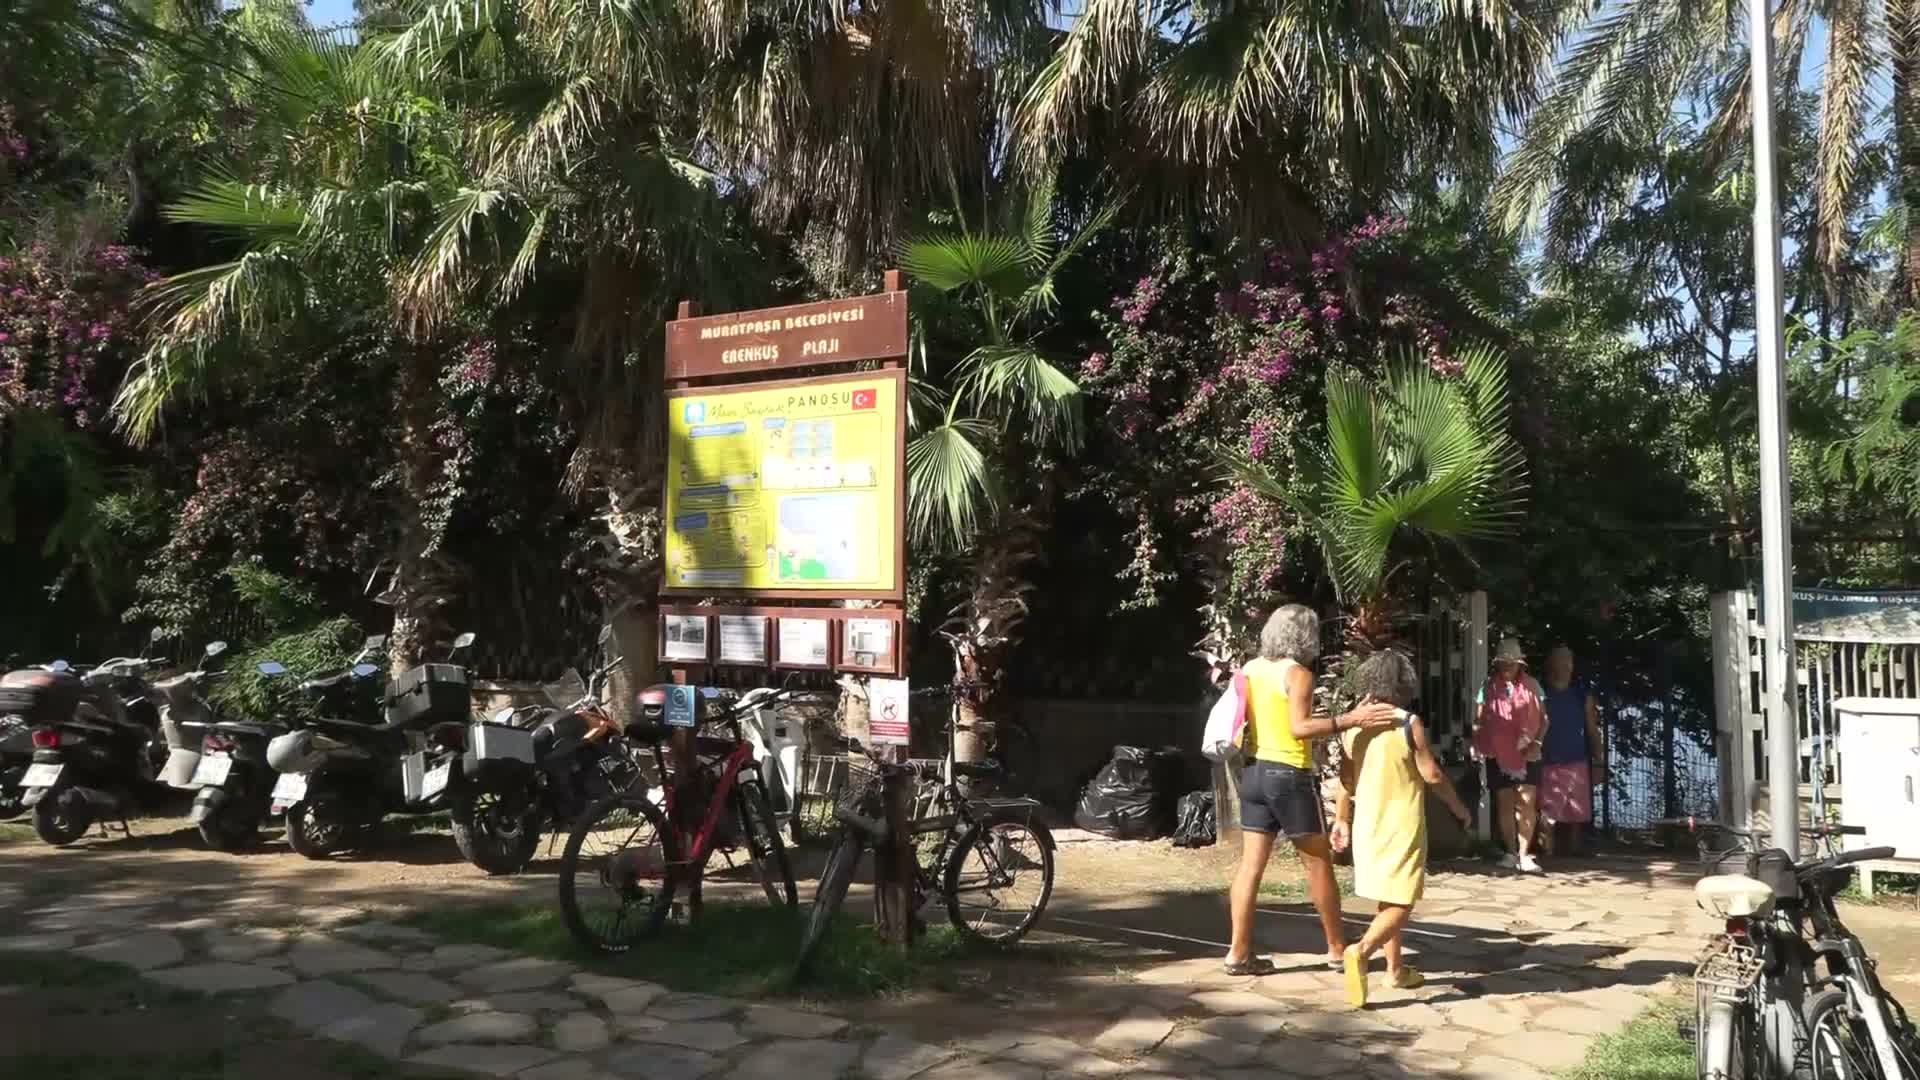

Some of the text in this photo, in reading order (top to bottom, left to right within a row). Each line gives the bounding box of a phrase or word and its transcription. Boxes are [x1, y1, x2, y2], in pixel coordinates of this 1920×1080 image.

[701, 305, 864, 340] MURATPAŞA BELEDİYESİ
[721, 338, 839, 364] ERENKUŞ PLAJI
[787, 391, 850, 408] PANOSU
